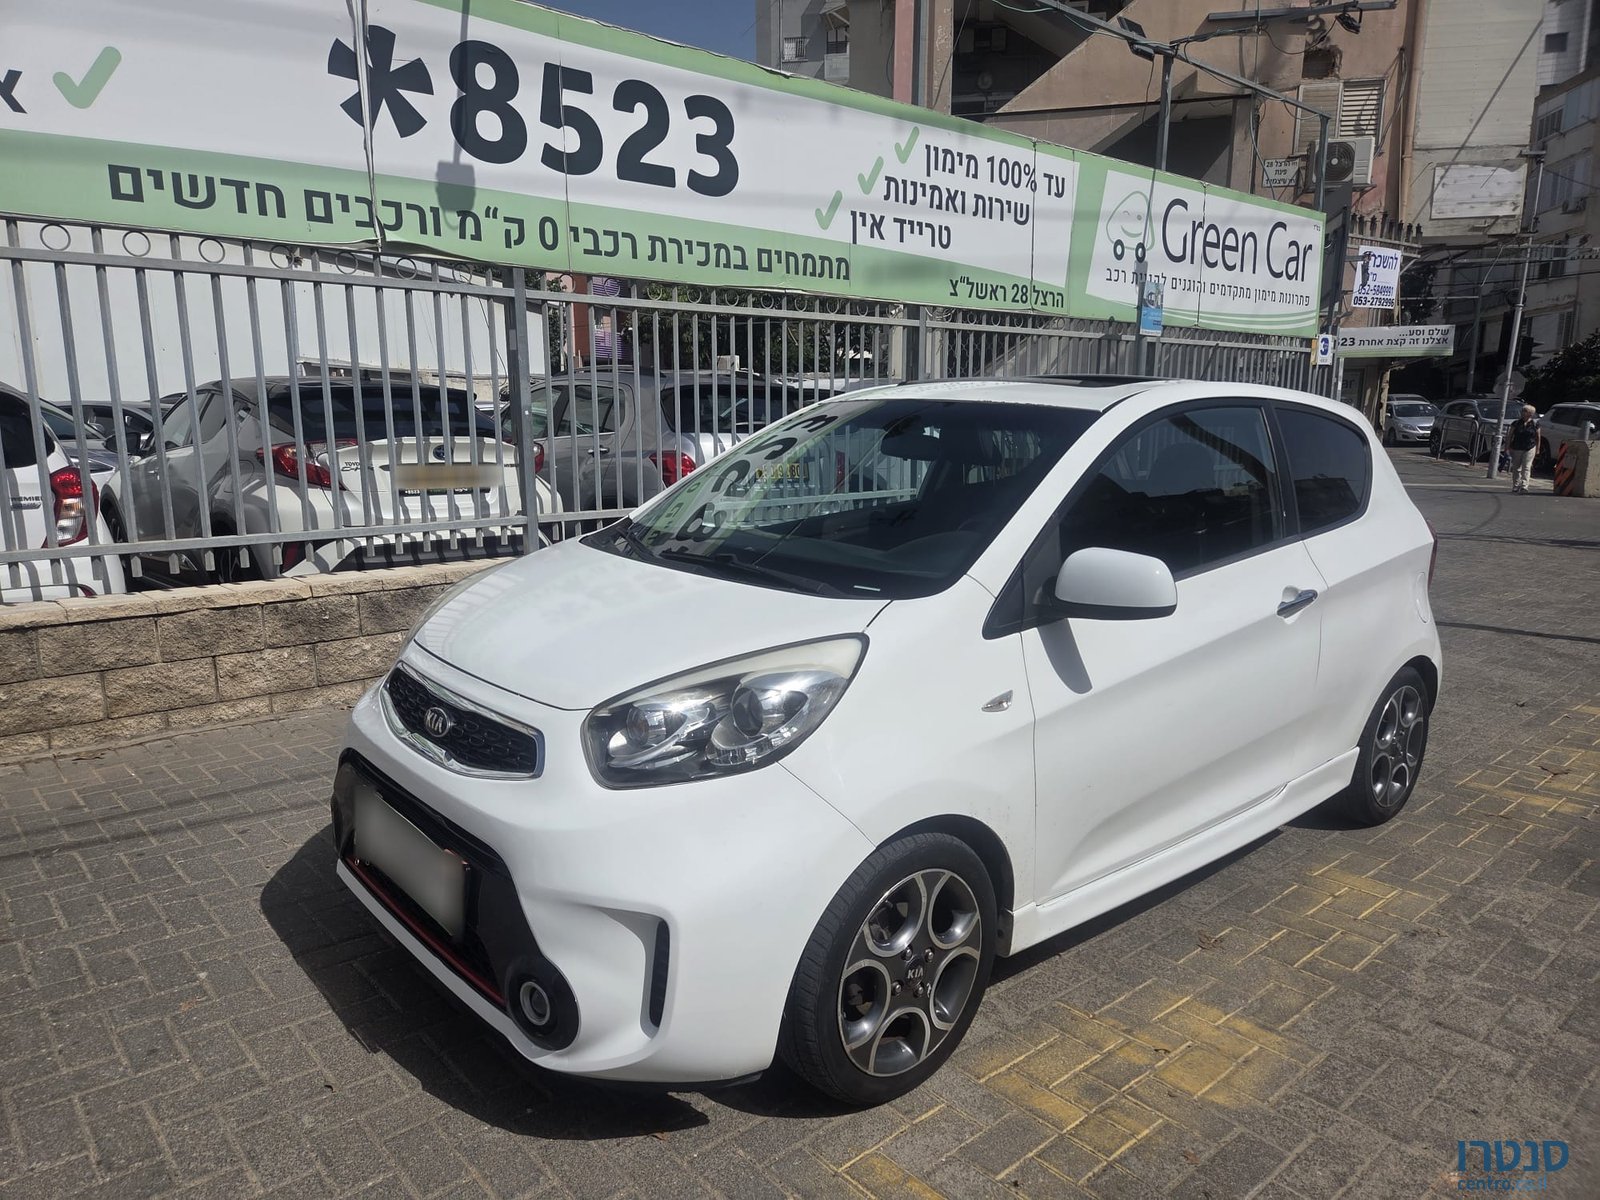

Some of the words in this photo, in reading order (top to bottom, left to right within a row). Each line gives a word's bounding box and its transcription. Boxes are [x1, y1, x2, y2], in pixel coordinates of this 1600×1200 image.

[925, 144, 979, 179] מימון
[987, 155, 1037, 192] 100%
[108, 164, 287, 219] חדשים
[884, 175, 966, 214] ואמינות
[1043, 172, 1065, 198] עד
[304, 189, 441, 238] ורכבים
[972, 193, 1030, 225] שירות
[850, 210, 885, 245] אין
[893, 217, 951, 249] טרייד
[1162, 198, 1259, 274] Green
[1266, 221, 1313, 282] Car
[570, 226, 638, 260] רכבי
[649, 234, 748, 271] במכירת
[758, 248, 850, 281] מתמחים
[1106, 267, 1127, 283] רכב
[1011, 284, 1028, 304] 28
[1033, 283, 1064, 308] הרצל
[1171, 277, 1206, 294] והוגנים
[1210, 282, 1251, 299] מתקדמים
[1254, 287, 1276, 303] מימון
[1279, 291, 1310, 307] פתרונות
[1358, 339, 1383, 347] אחרת
[1386, 338, 1406, 347] קצת
[1422, 337, 1449, 345] אצלנו
[1427, 328, 1449, 336] שלם
[425, 709, 443, 734] KIA
[907, 967, 924, 979] KIA
